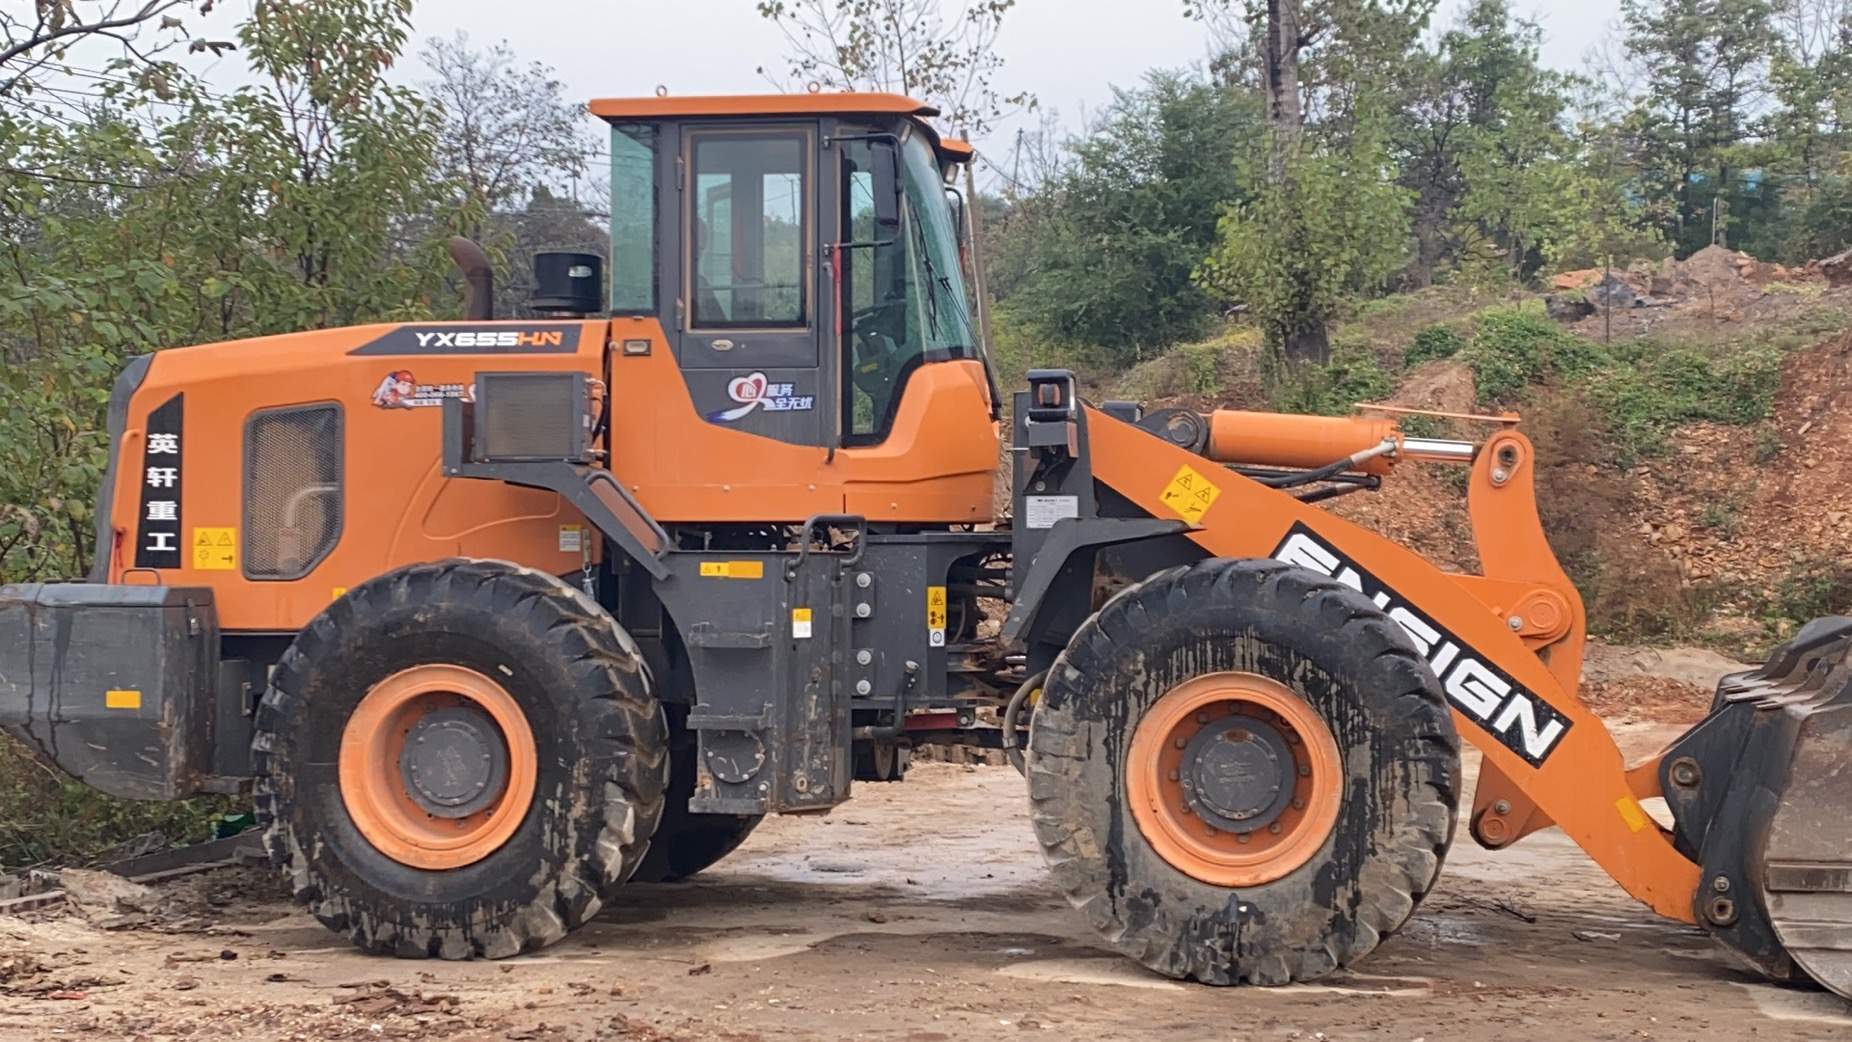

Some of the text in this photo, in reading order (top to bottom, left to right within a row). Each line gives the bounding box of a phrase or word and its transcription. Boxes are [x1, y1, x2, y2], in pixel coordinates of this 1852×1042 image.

[415, 331, 563, 347] YX655HN
[146, 433, 178, 551] 英轩重工
